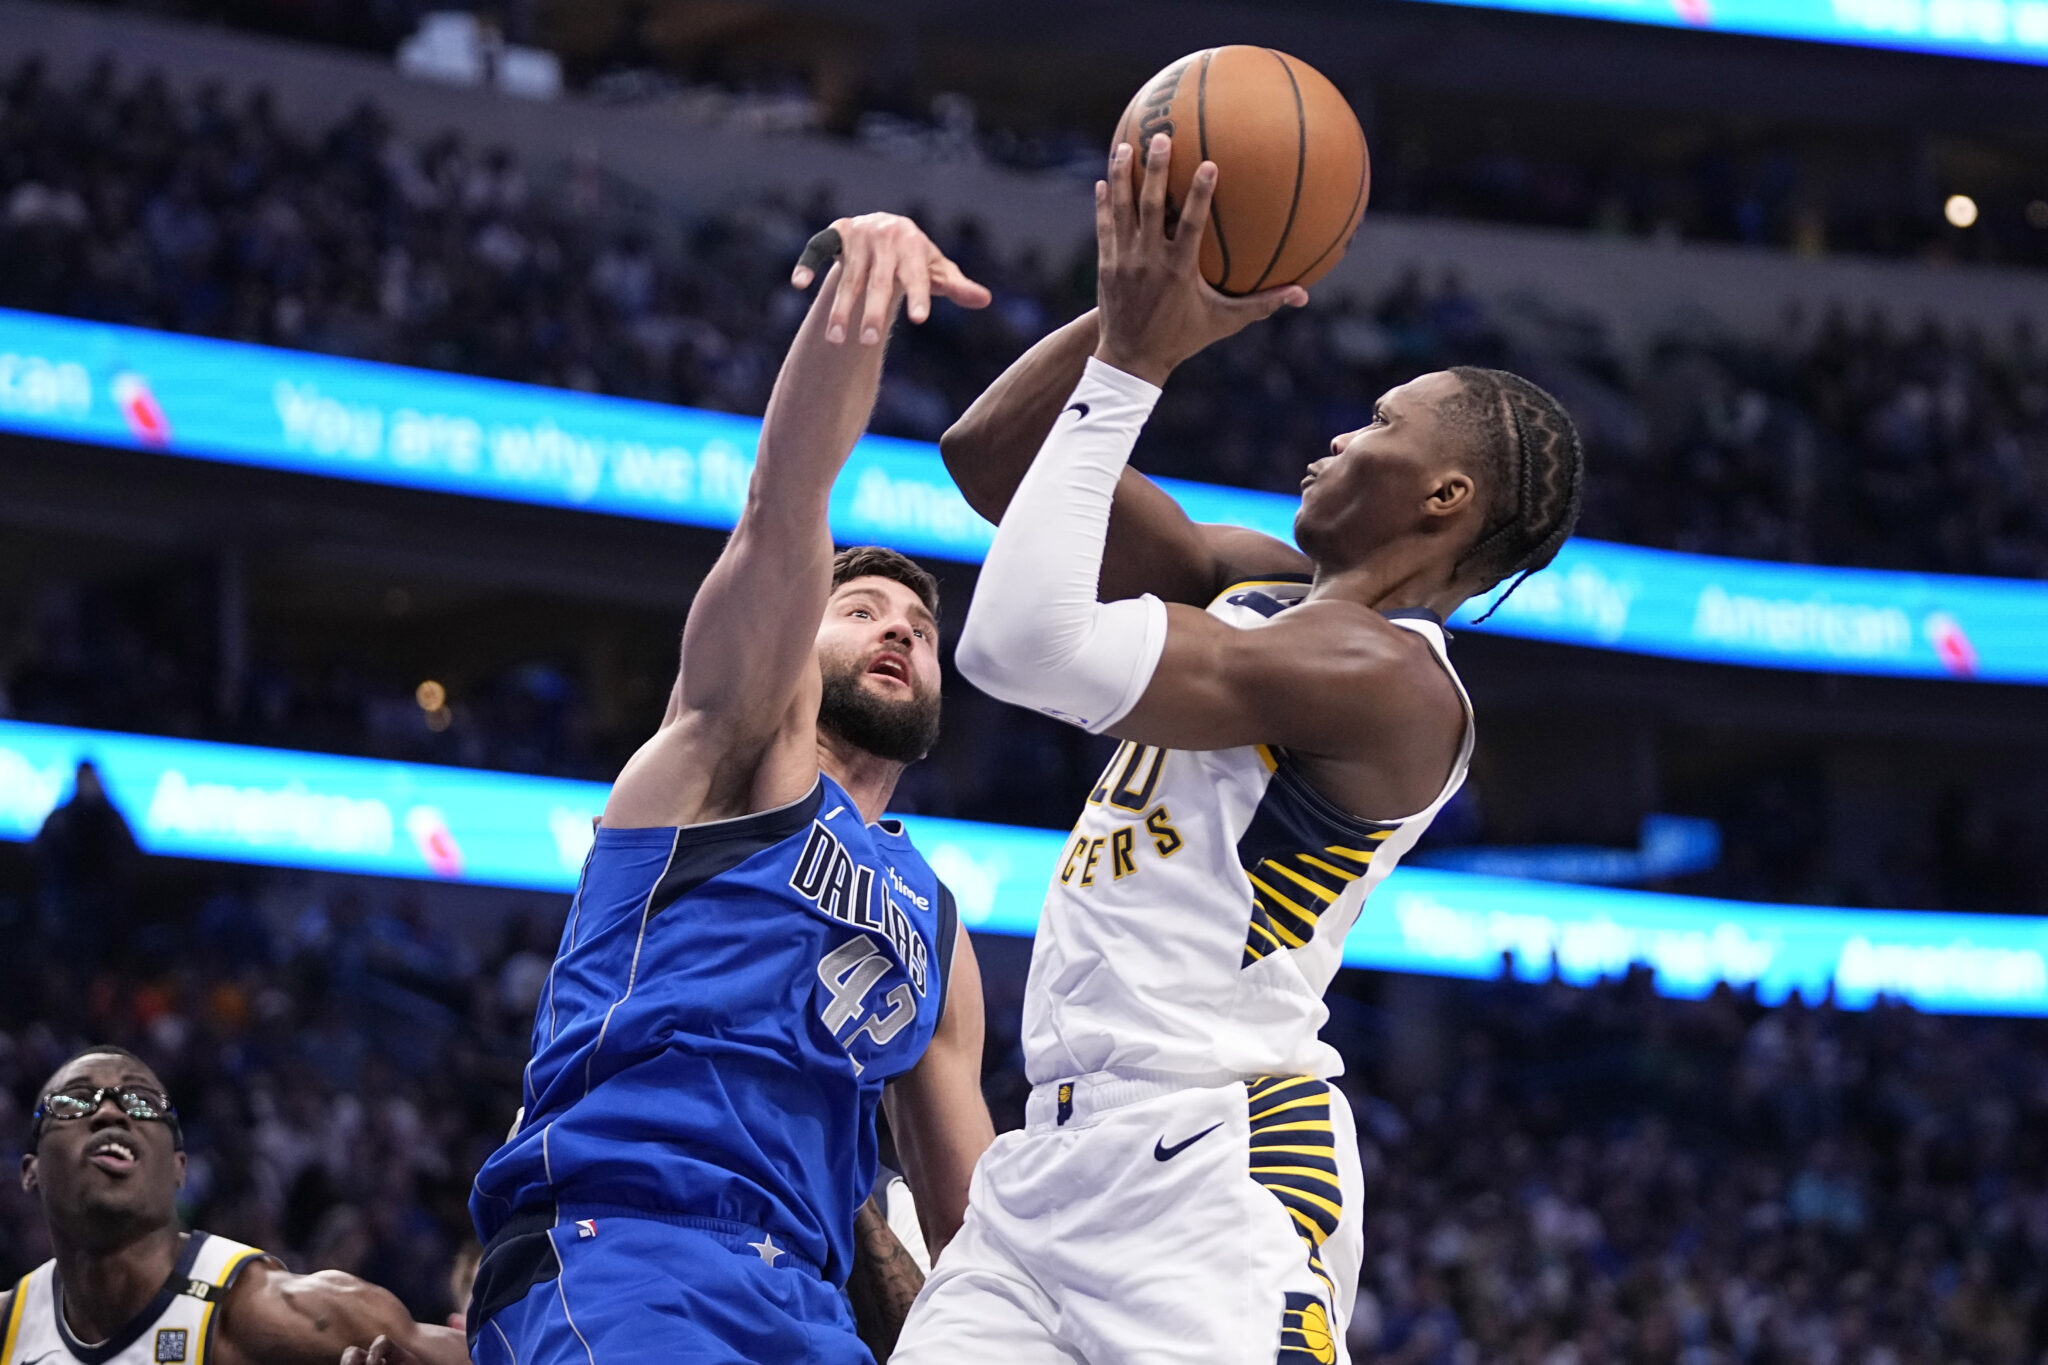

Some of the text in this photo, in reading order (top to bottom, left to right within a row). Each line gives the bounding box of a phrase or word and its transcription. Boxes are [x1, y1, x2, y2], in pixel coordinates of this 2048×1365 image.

[272, 379, 383, 459] You
[388, 409, 483, 474] are
[489, 418, 604, 503] why
[610, 440, 694, 502] we
[1692, 583, 1912, 660] American
[147, 769, 393, 856] American
[1060, 804, 1184, 887] CERS
[888, 865, 930, 911] hime
[817, 933, 917, 1077] 42
[187, 1280, 210, 1299] 30
